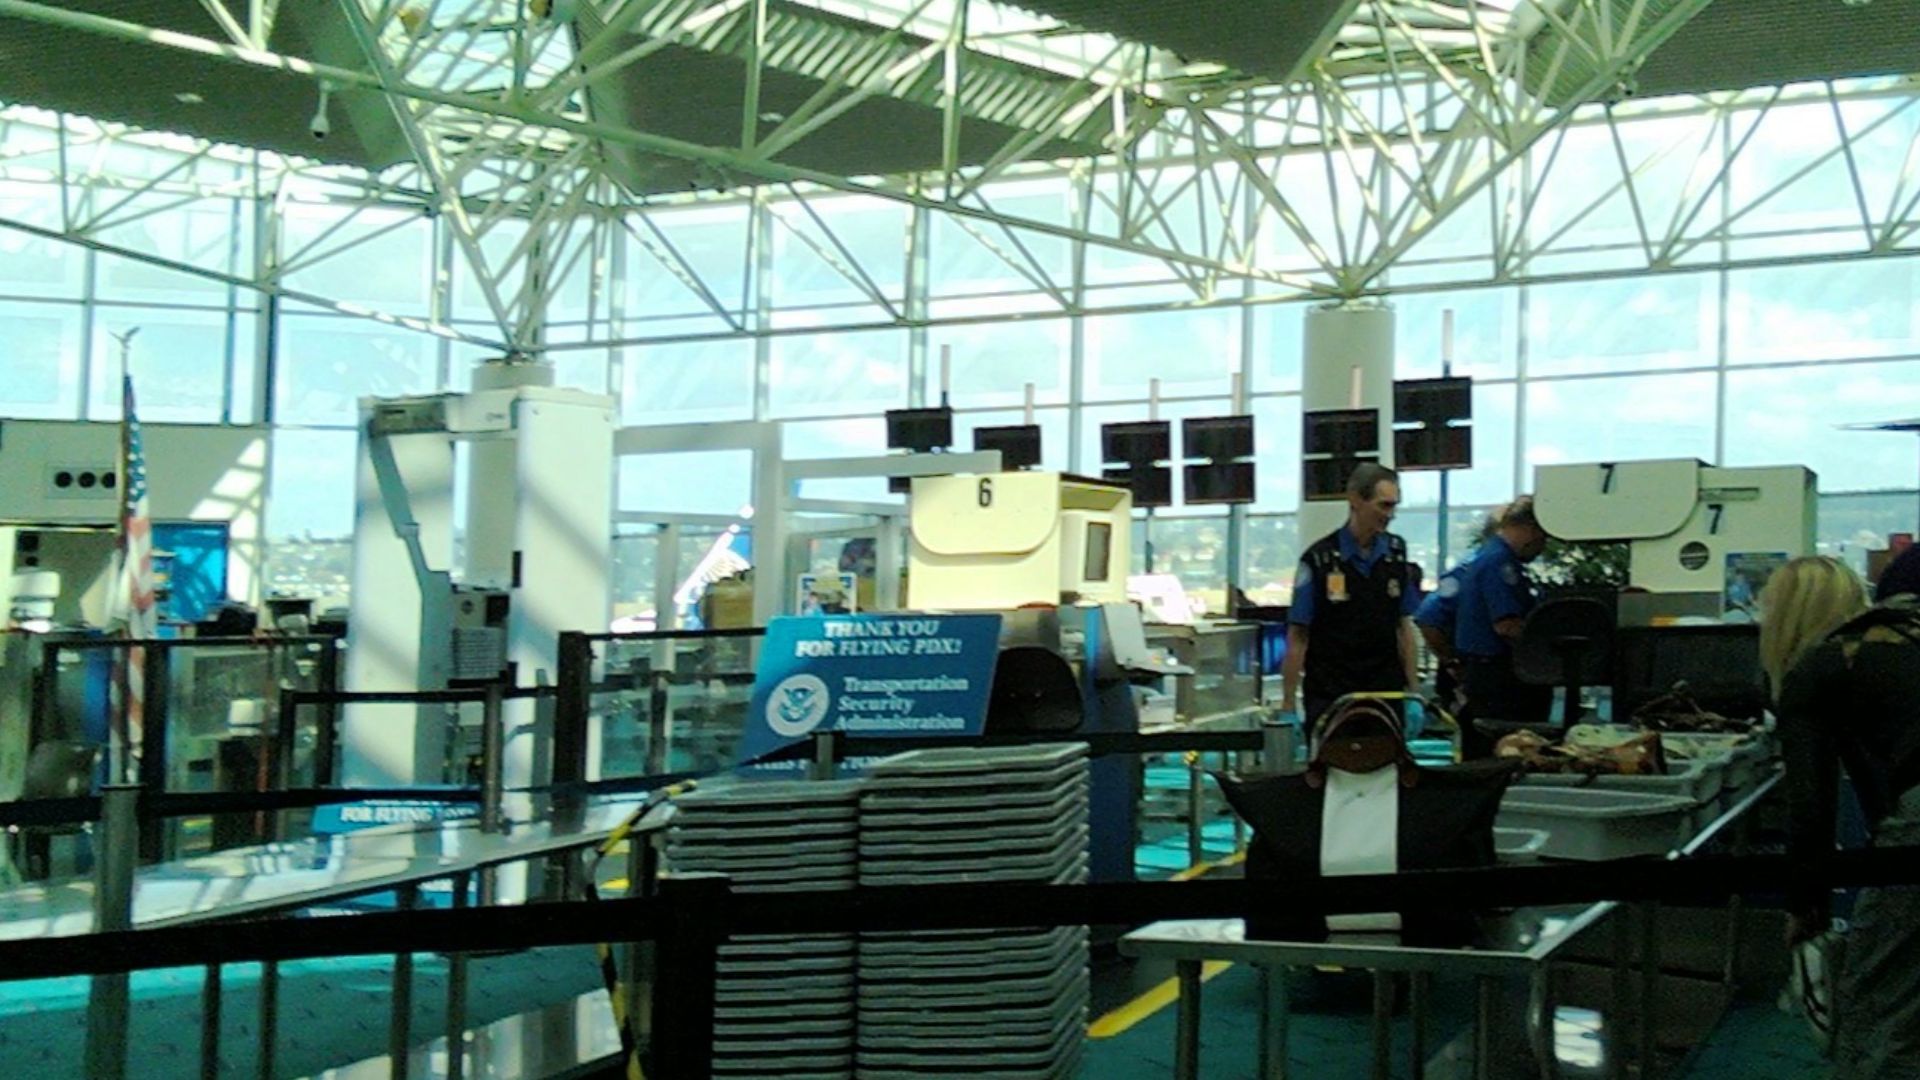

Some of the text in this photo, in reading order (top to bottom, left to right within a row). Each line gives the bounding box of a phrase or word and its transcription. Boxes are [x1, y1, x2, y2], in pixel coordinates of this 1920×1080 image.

[1600, 463, 1616, 494] 7
[979, 477, 993, 508] 6
[1707, 503, 1723, 535] 7
[824, 620, 940, 638] THANK YOU
[796, 638, 962, 657] FOR FLYING PDX!
[844, 675, 969, 696] Transportation
[838, 696, 916, 714] Security
[833, 714, 965, 730] Administration
[340, 806, 373, 822] FOR
[375, 806, 433, 821] FLYING
